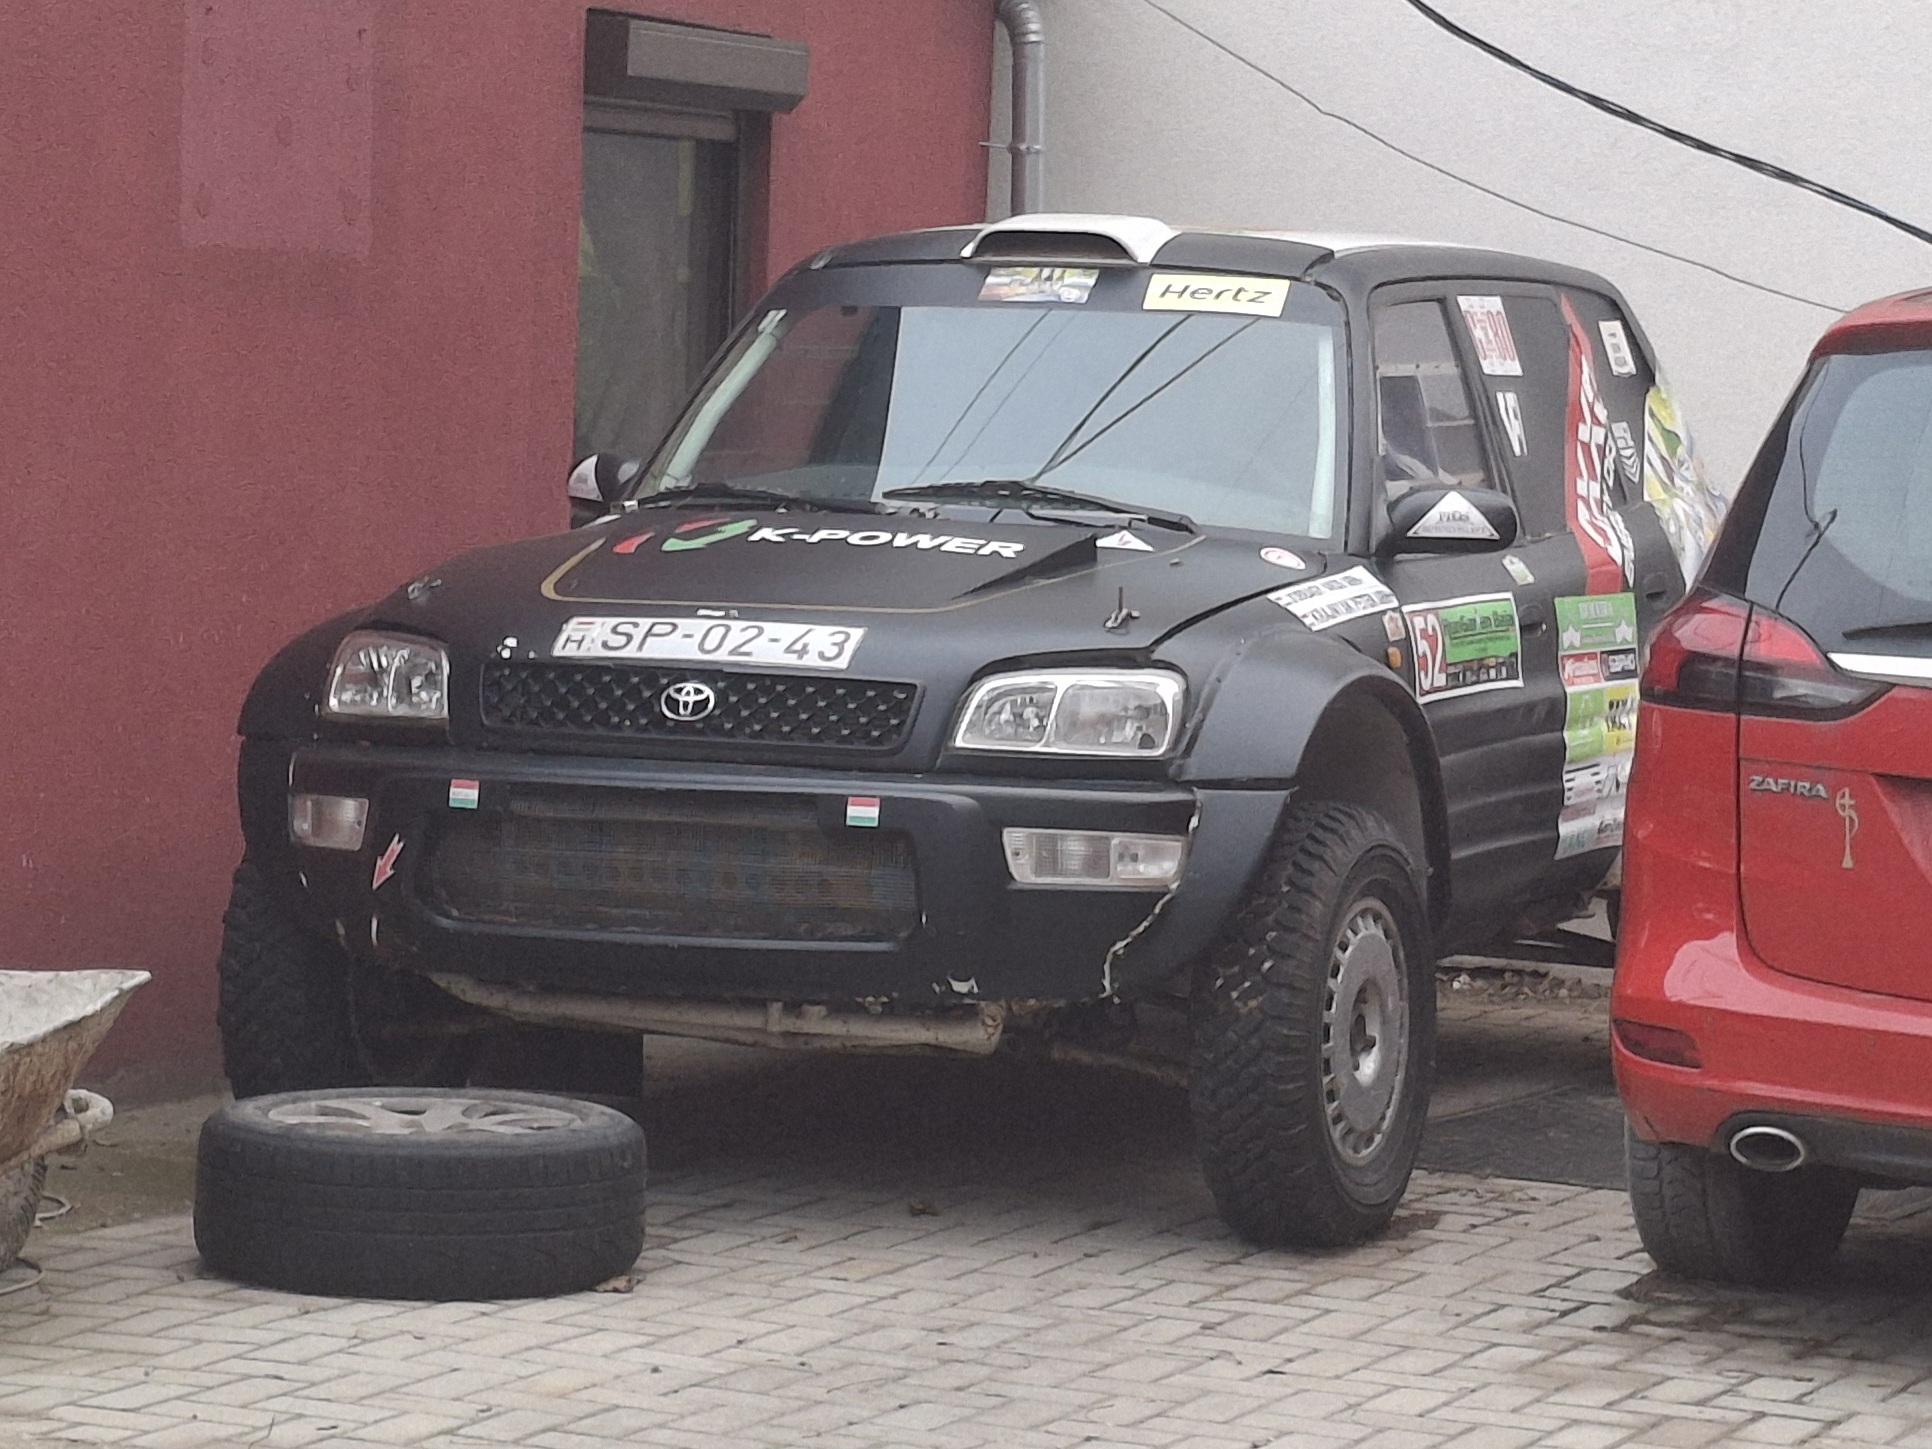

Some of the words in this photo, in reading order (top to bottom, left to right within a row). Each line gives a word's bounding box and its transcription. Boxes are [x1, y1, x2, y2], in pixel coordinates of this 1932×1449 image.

[1158, 283, 1272, 305] Hertz
[748, 526, 1025, 559] K-POWER
[601, 621, 852, 662] SP-02-43
[1412, 612, 1448, 692] 52
[1749, 775, 1828, 800] ZAFIRA
